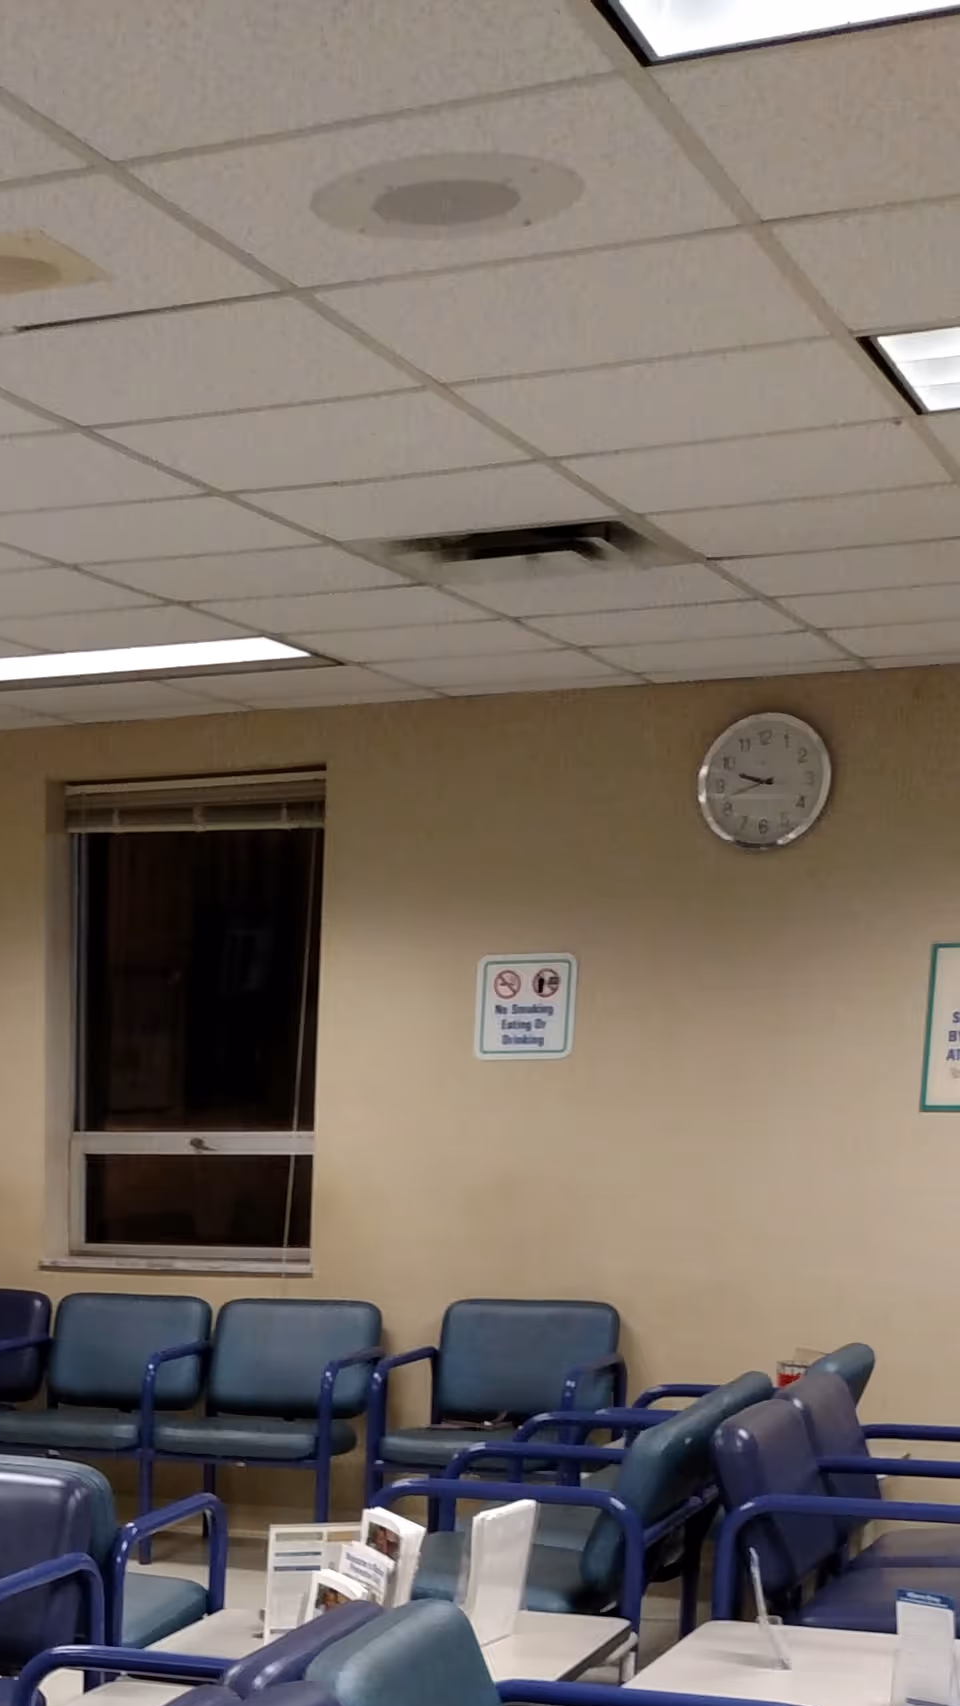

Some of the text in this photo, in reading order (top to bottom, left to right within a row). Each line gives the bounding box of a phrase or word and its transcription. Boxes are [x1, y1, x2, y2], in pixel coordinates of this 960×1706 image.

[758, 730, 773, 745] 12
[784, 733, 790, 748] 1
[739, 738, 751, 752] 11
[797, 748, 808, 763] 2
[722, 756, 735, 770] 10
[795, 795, 805, 808] 4
[739, 815, 749, 830] 7
[758, 818, 768, 834] 6
[495, 1004, 554, 1016] No Smoking
[501, 1018, 547, 1031] Eating Or
[501, 1034, 545, 1047] Drinking
